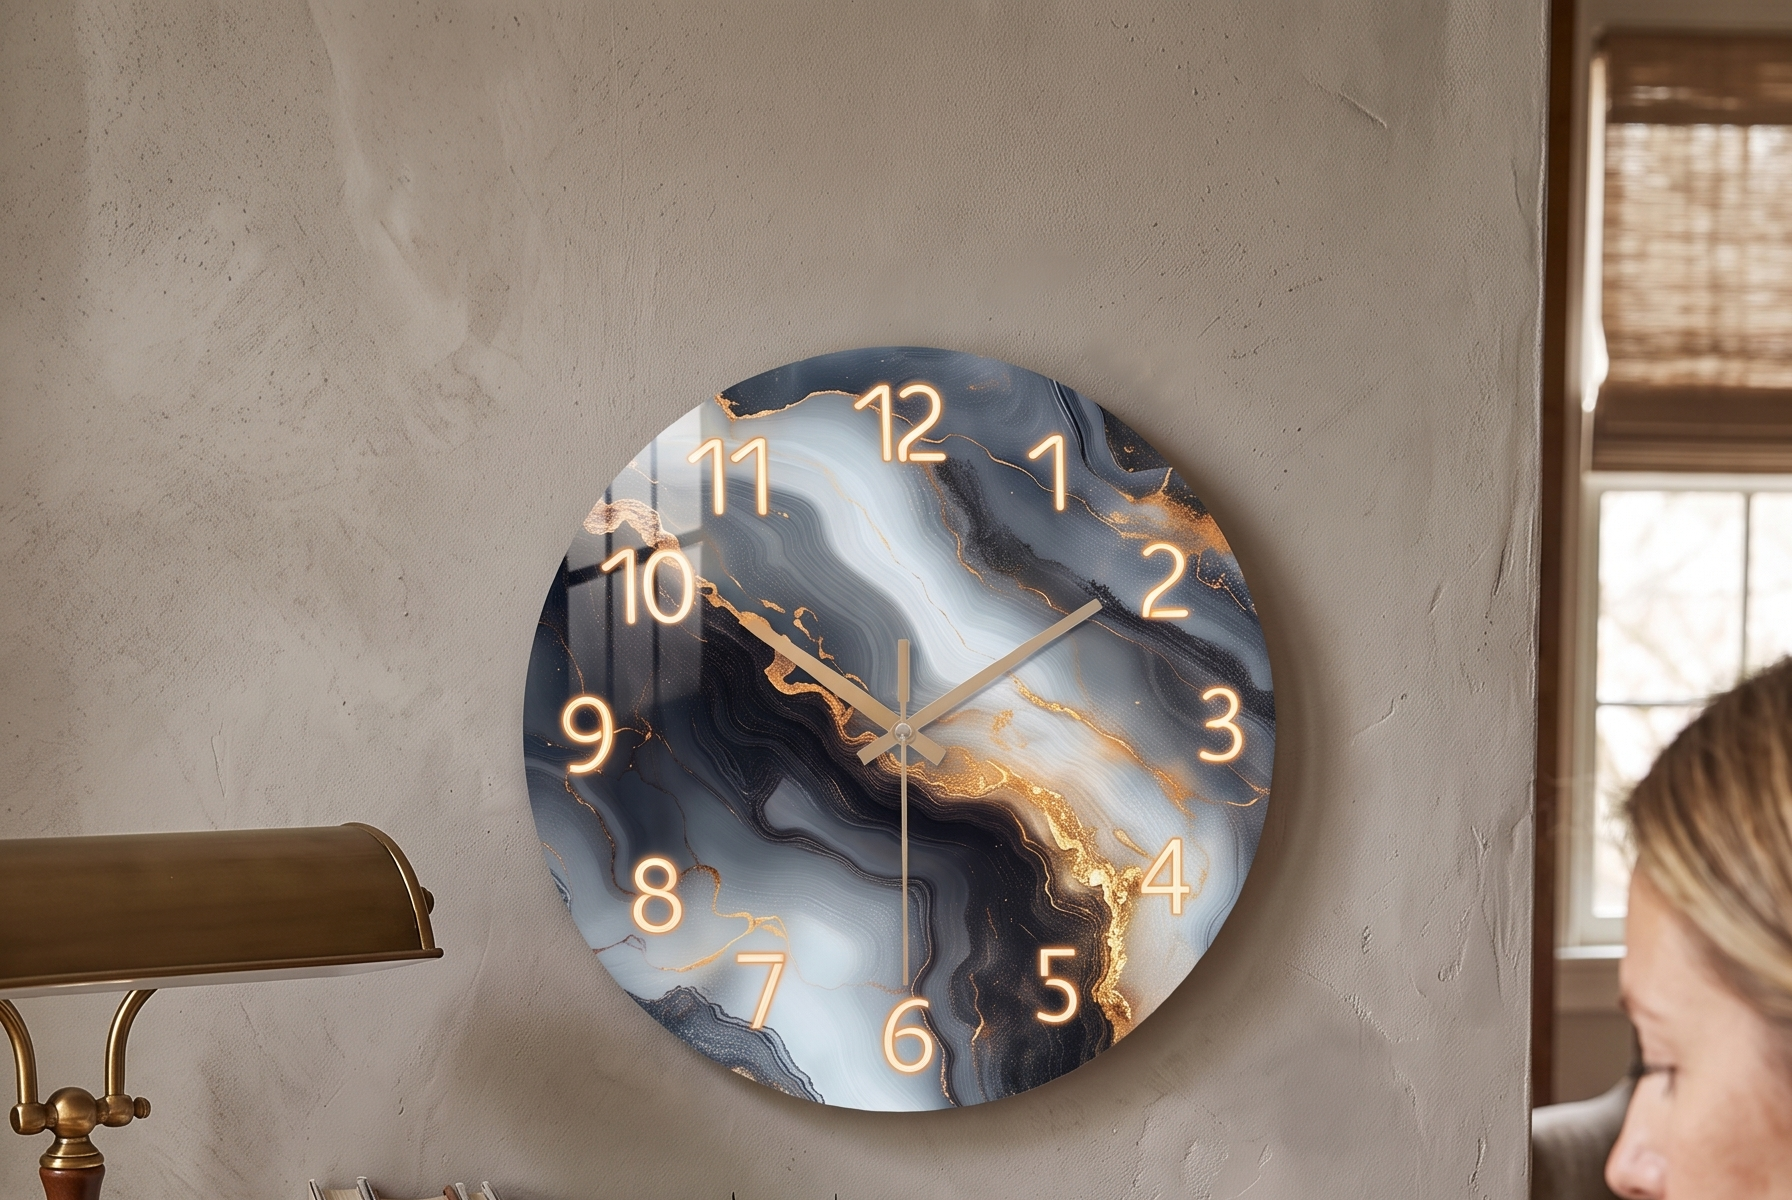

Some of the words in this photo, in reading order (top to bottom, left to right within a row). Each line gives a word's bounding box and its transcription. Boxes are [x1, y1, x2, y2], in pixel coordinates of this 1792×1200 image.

[854, 384, 947, 463] 12
[687, 438, 769, 516] 11
[1029, 435, 1065, 511] 1
[601, 548, 694, 625] 10
[1140, 543, 1190, 619] 2
[561, 696, 615, 774] 9
[1199, 687, 1244, 763] 3
[631, 857, 684, 935] 8
[1139, 837, 1191, 917] 4
[735, 953, 787, 1030] 7
[1035, 948, 1078, 1024] 5
[882, 998, 935, 1074] 6
